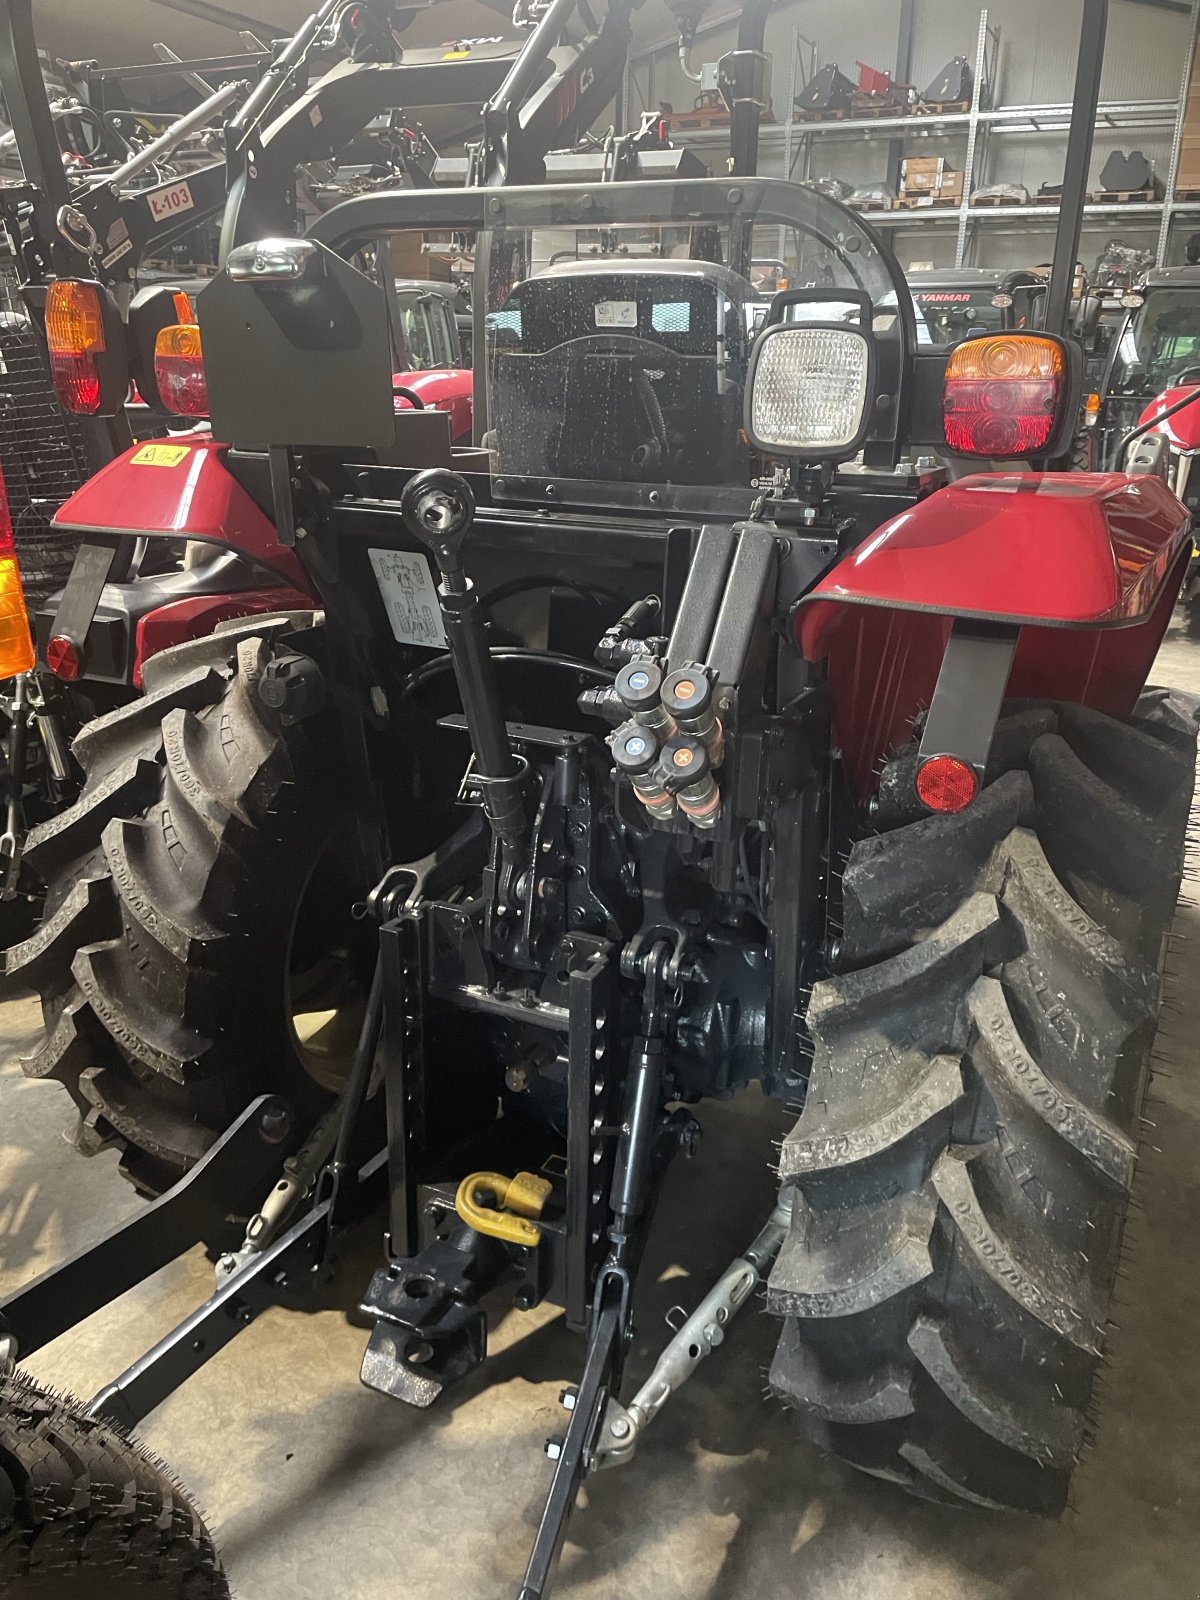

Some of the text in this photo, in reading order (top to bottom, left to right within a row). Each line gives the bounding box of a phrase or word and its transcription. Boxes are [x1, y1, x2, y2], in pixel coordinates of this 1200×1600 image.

[579, 66, 595, 95] C3
[921, 293, 971, 302] YANMAR
[990, 1017, 1080, 1136] 60/70R20
